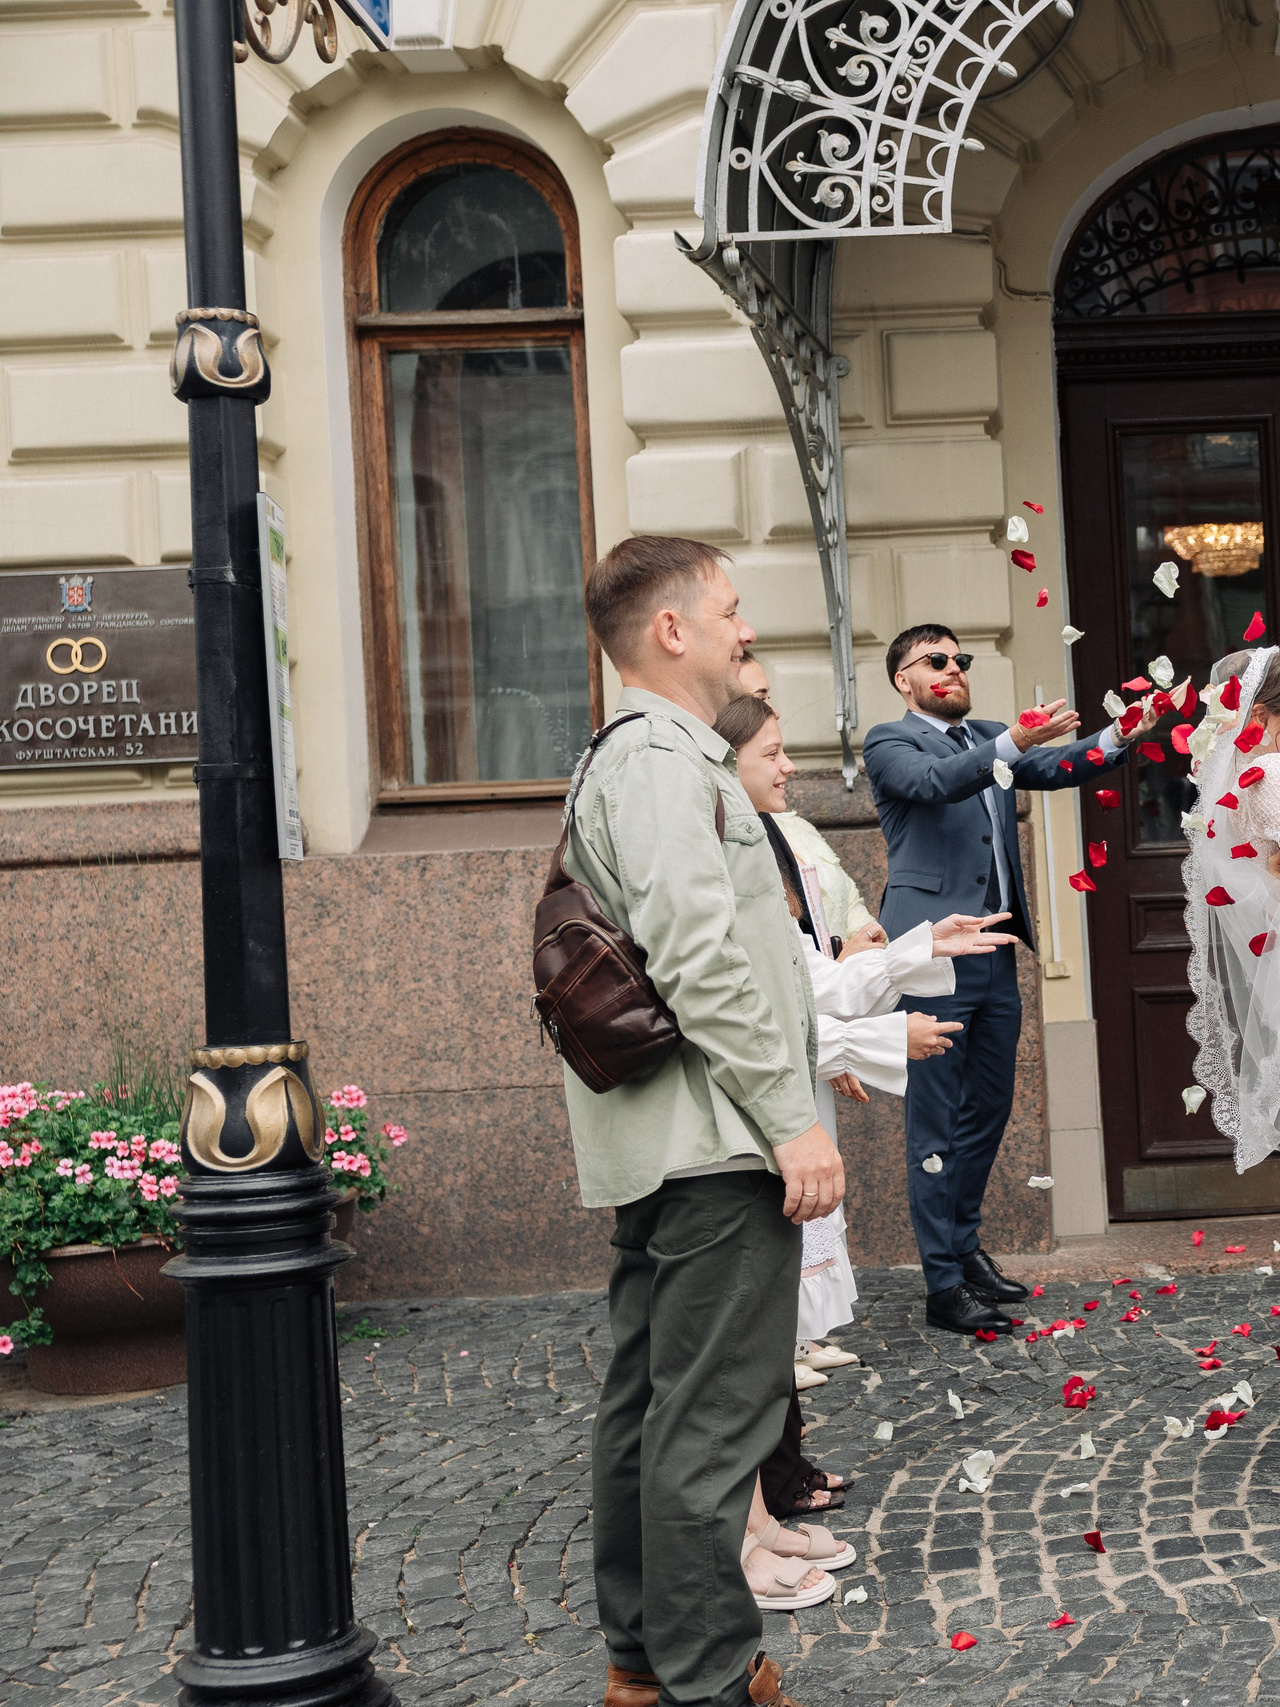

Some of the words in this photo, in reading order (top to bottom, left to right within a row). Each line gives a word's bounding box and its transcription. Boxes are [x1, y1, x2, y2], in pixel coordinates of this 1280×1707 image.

[1, 624, 27, 634] ДЕЛАМ
[33, 622, 62, 632] ЗАПИСИ
[67, 621, 91, 630] АКТОВ
[96, 619, 155, 629] ГРАЖДАНСКОГО
[3, 615, 66, 625] ПРАВИТЕЛЬСТВО
[15, 679, 141, 711] ДВОРЕЦ
[15, 746, 118, 762] ФУРШТАТСКАЯ,
[125, 743, 144, 757] 52
